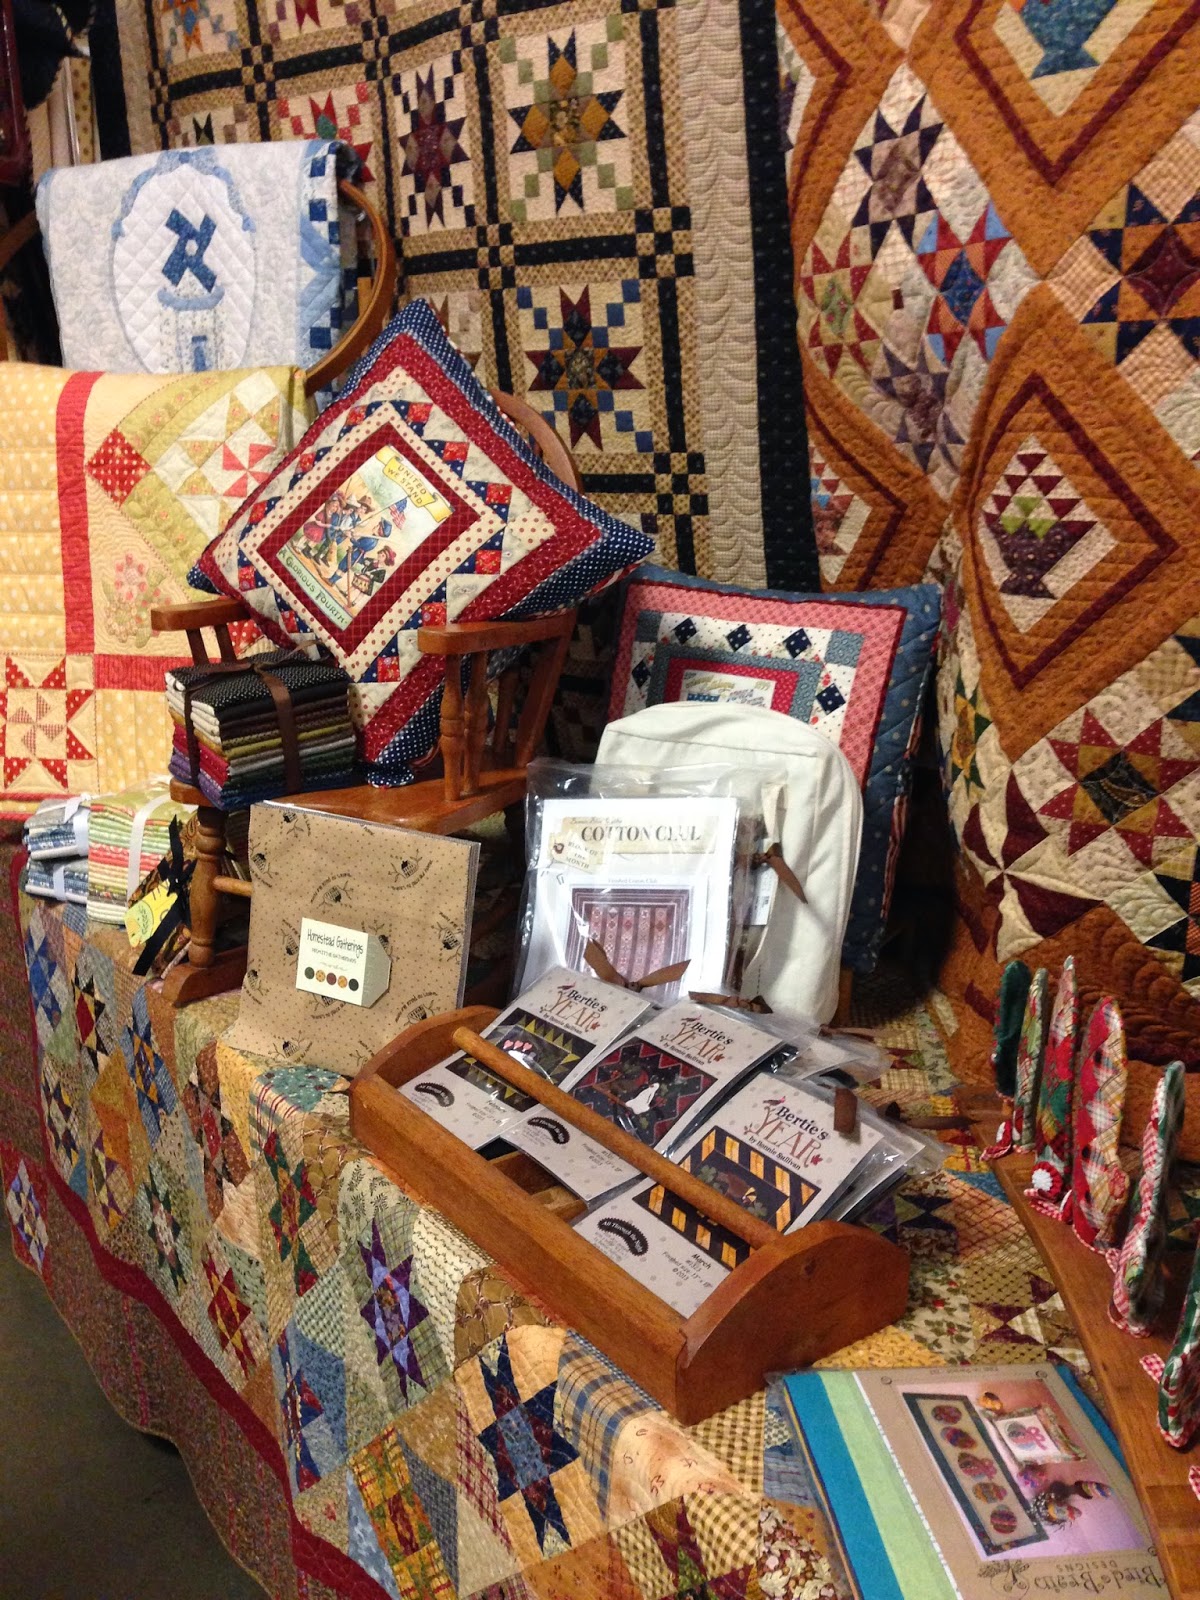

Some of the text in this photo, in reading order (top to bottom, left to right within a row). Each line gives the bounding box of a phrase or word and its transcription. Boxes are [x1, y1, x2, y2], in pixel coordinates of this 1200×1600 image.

[387, 467, 424, 505] WE STAND
[397, 464, 427, 496] UNITED
[307, 929, 335, 947] Homestead
[336, 935, 364, 959] Gatherings
[548, 990, 601, 1033] YEAR
[567, 989, 608, 1012] Bertie's
[670, 1021, 726, 1064] YEAR
[691, 1022, 734, 1046] Bertie's
[754, 1105, 822, 1168] YEAR
[776, 1105, 829, 1140] Bertie's
[748, 1135, 801, 1170] by Bonnie Sullivan
[691, 1253, 711, 1270] March
[1034, 1570, 1104, 1594] Brain
[1056, 1560, 1118, 1573] DESIGNS
